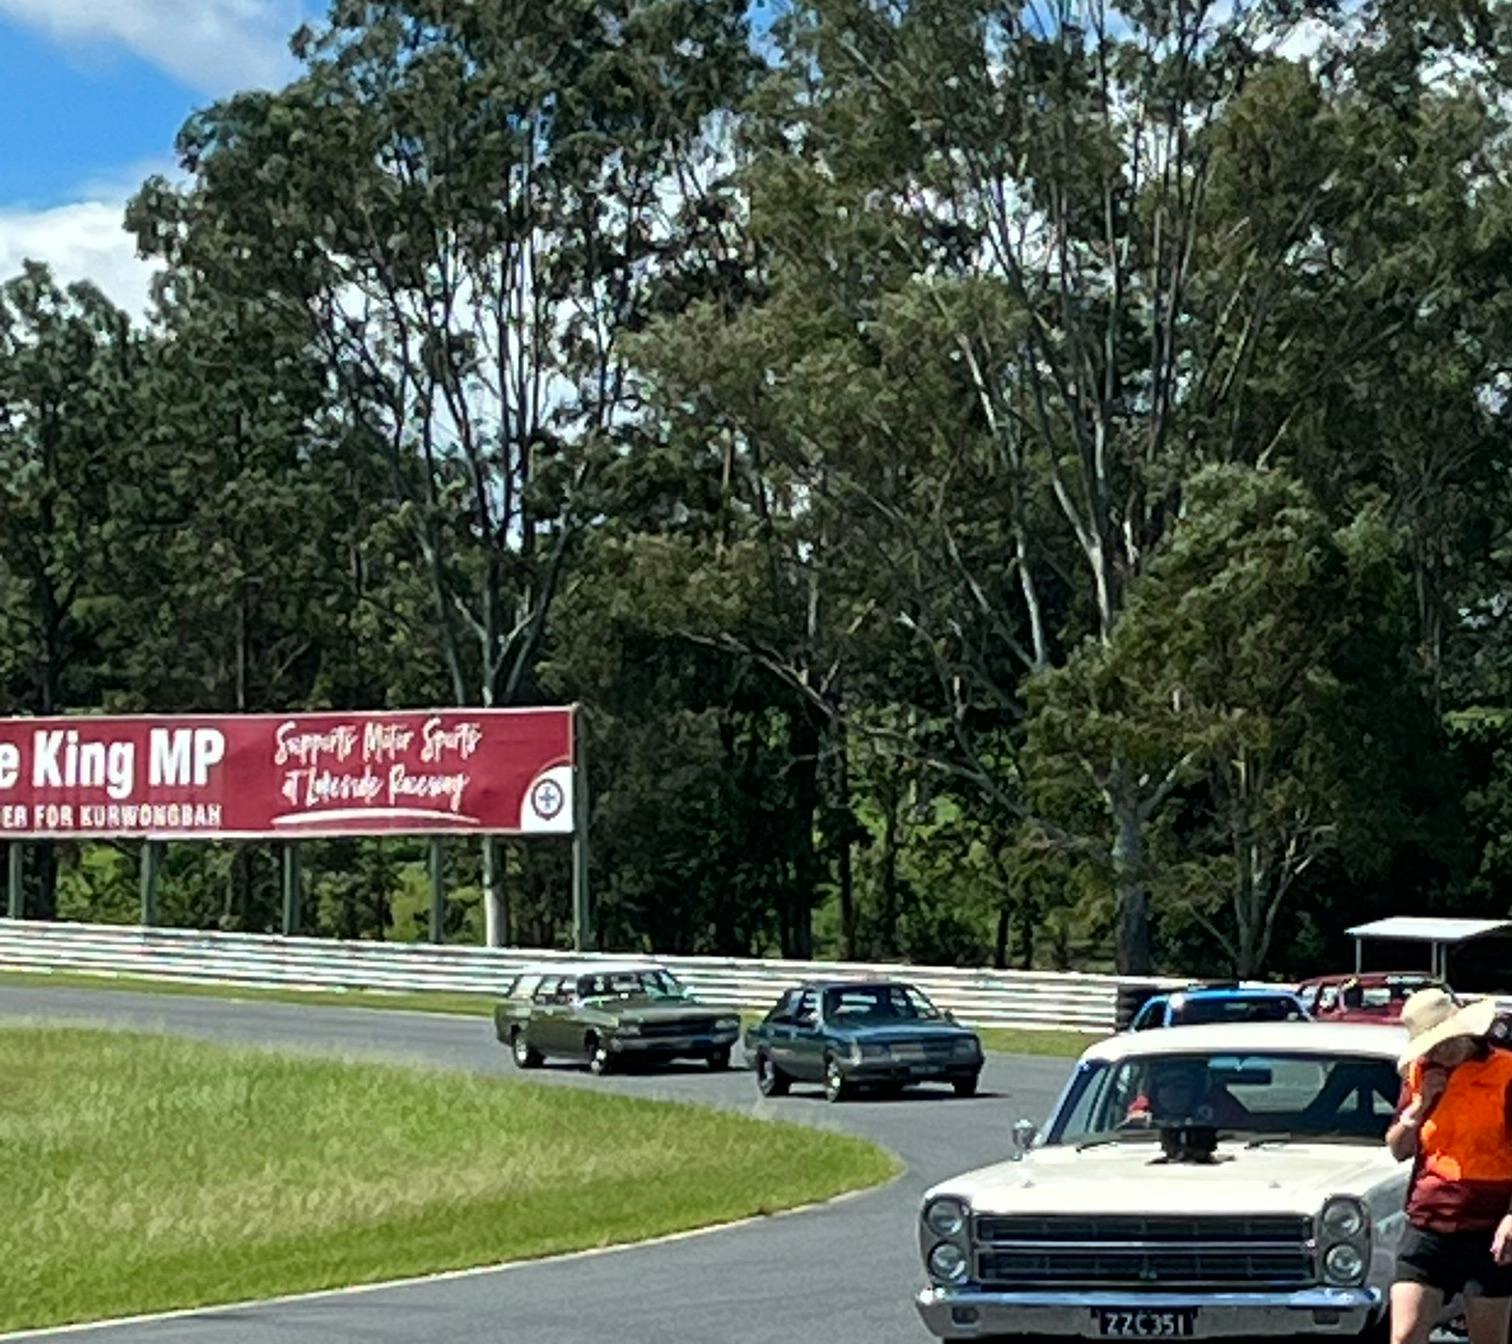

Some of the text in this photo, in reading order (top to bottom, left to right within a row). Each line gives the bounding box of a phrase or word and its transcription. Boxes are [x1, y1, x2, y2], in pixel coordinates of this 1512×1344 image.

[33, 730, 135, 799] King
[149, 728, 225, 786] MP
[275, 718, 482, 766] Supports Motor Sports
[305, 766, 384, 807] Lakeside
[390, 763, 470, 812] Raceway
[34, 804, 74, 827] FOR
[80, 803, 222, 828] KURWONGBAH
